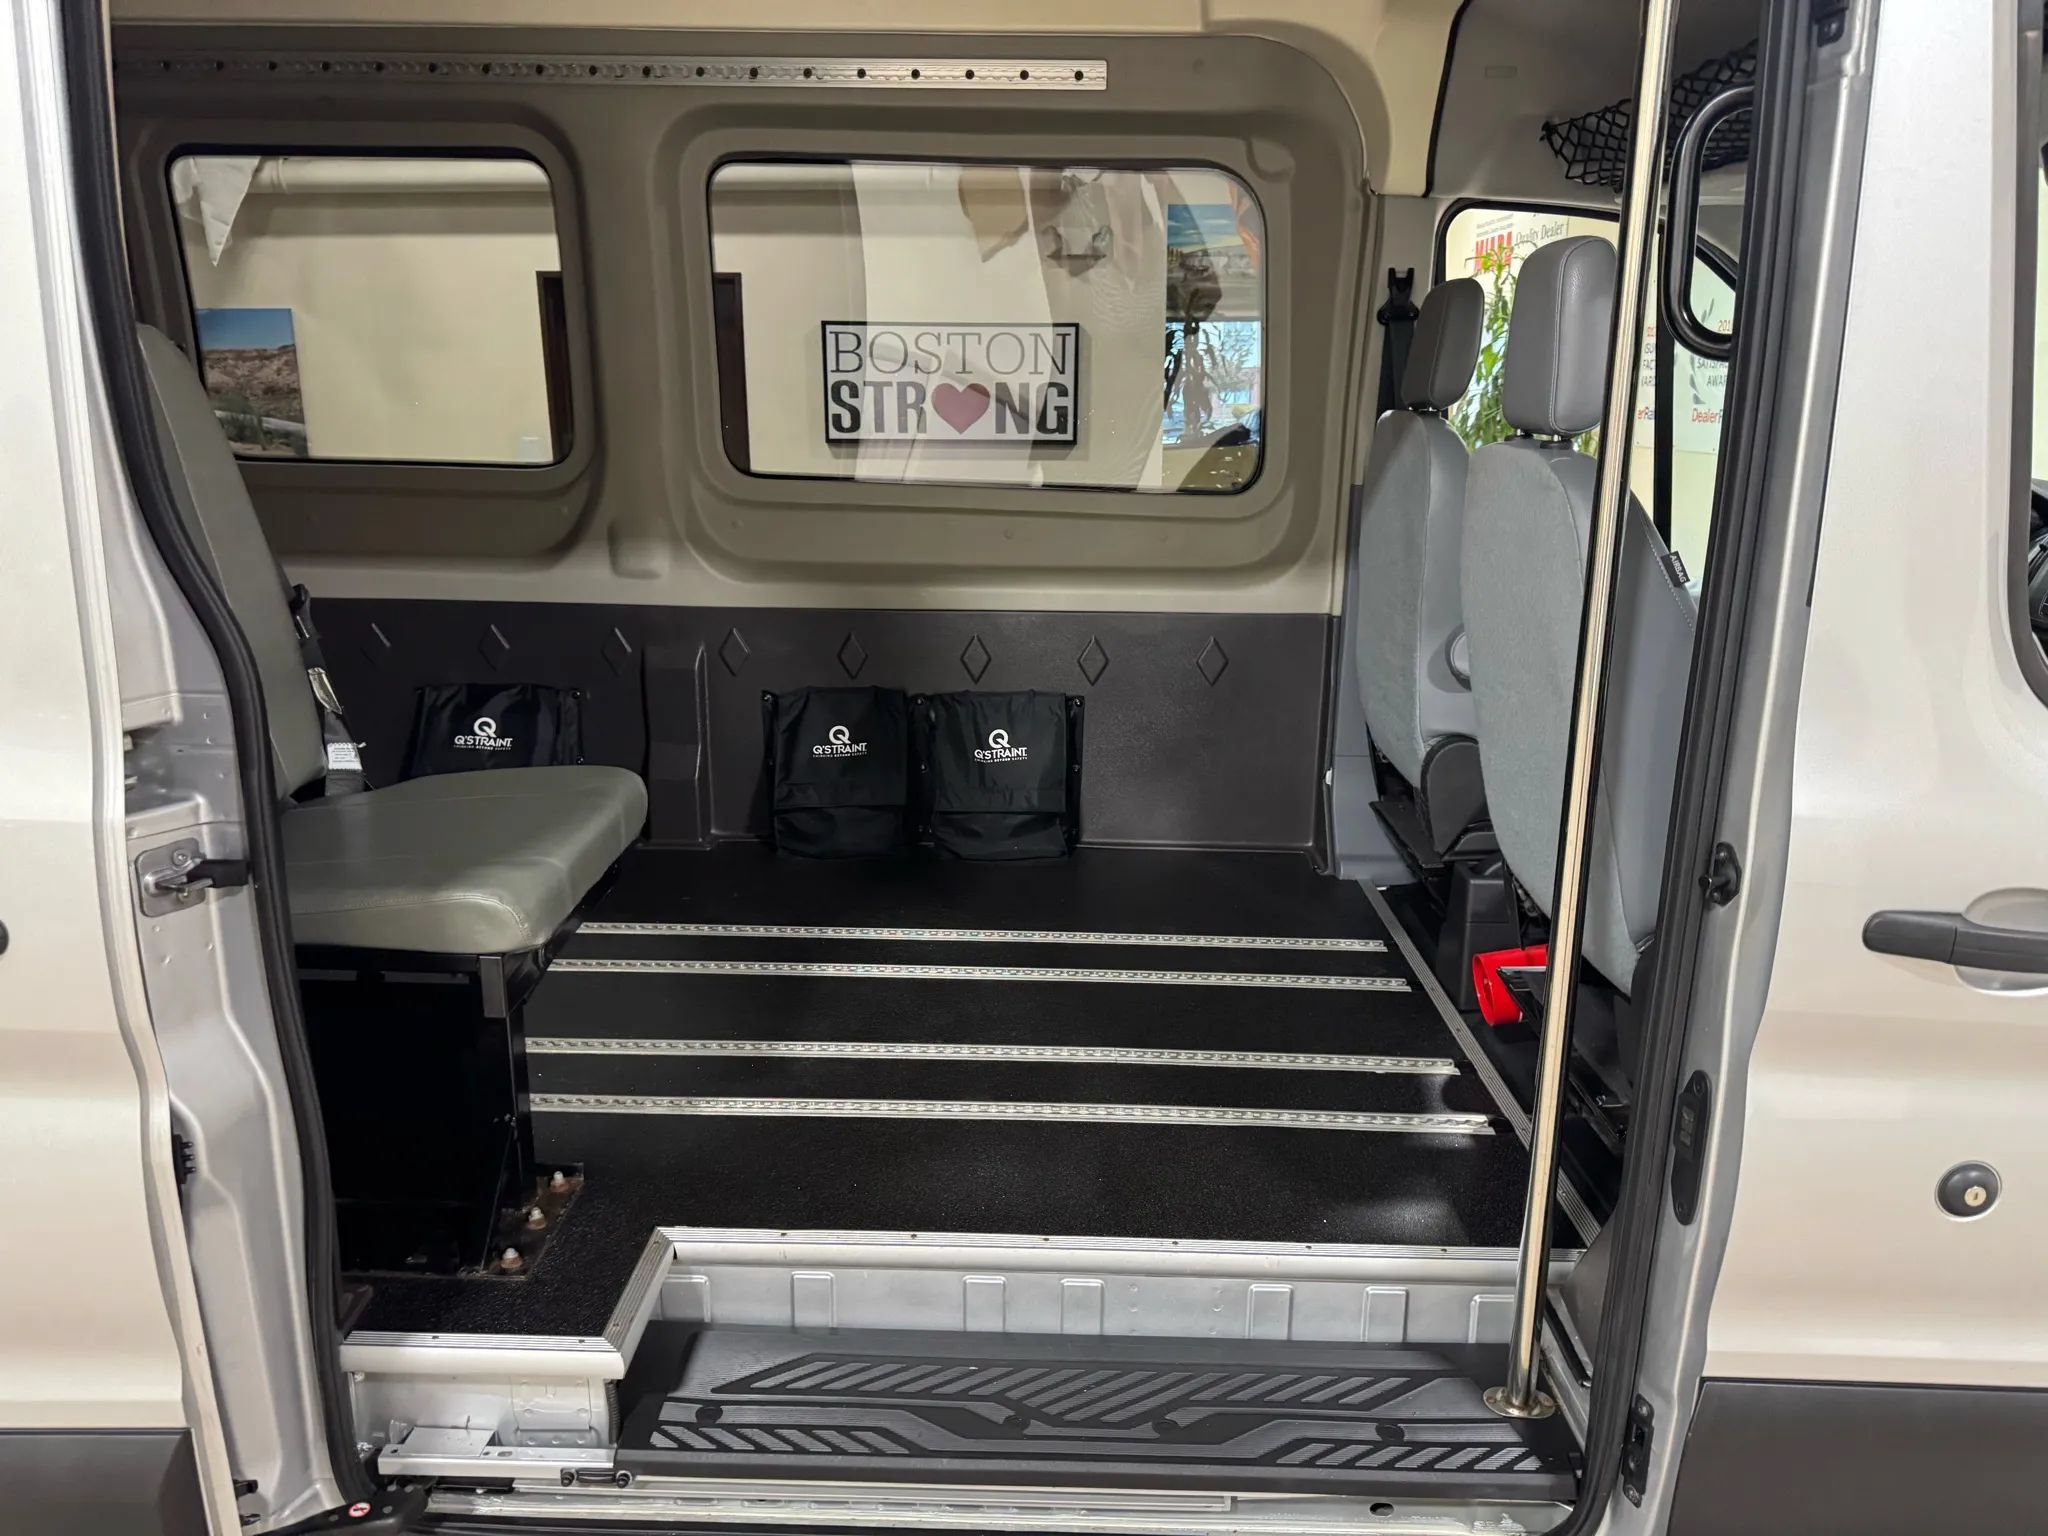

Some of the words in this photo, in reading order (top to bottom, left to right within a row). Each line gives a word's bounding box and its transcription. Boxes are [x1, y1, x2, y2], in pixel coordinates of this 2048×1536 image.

[1540, 221, 1564, 240] Dealer
[1717, 319, 1731, 332] 201
[829, 331, 1072, 375] BOSTON
[830, 379, 1069, 434] STRNG
[1670, 554, 1687, 583] AIRBAG
